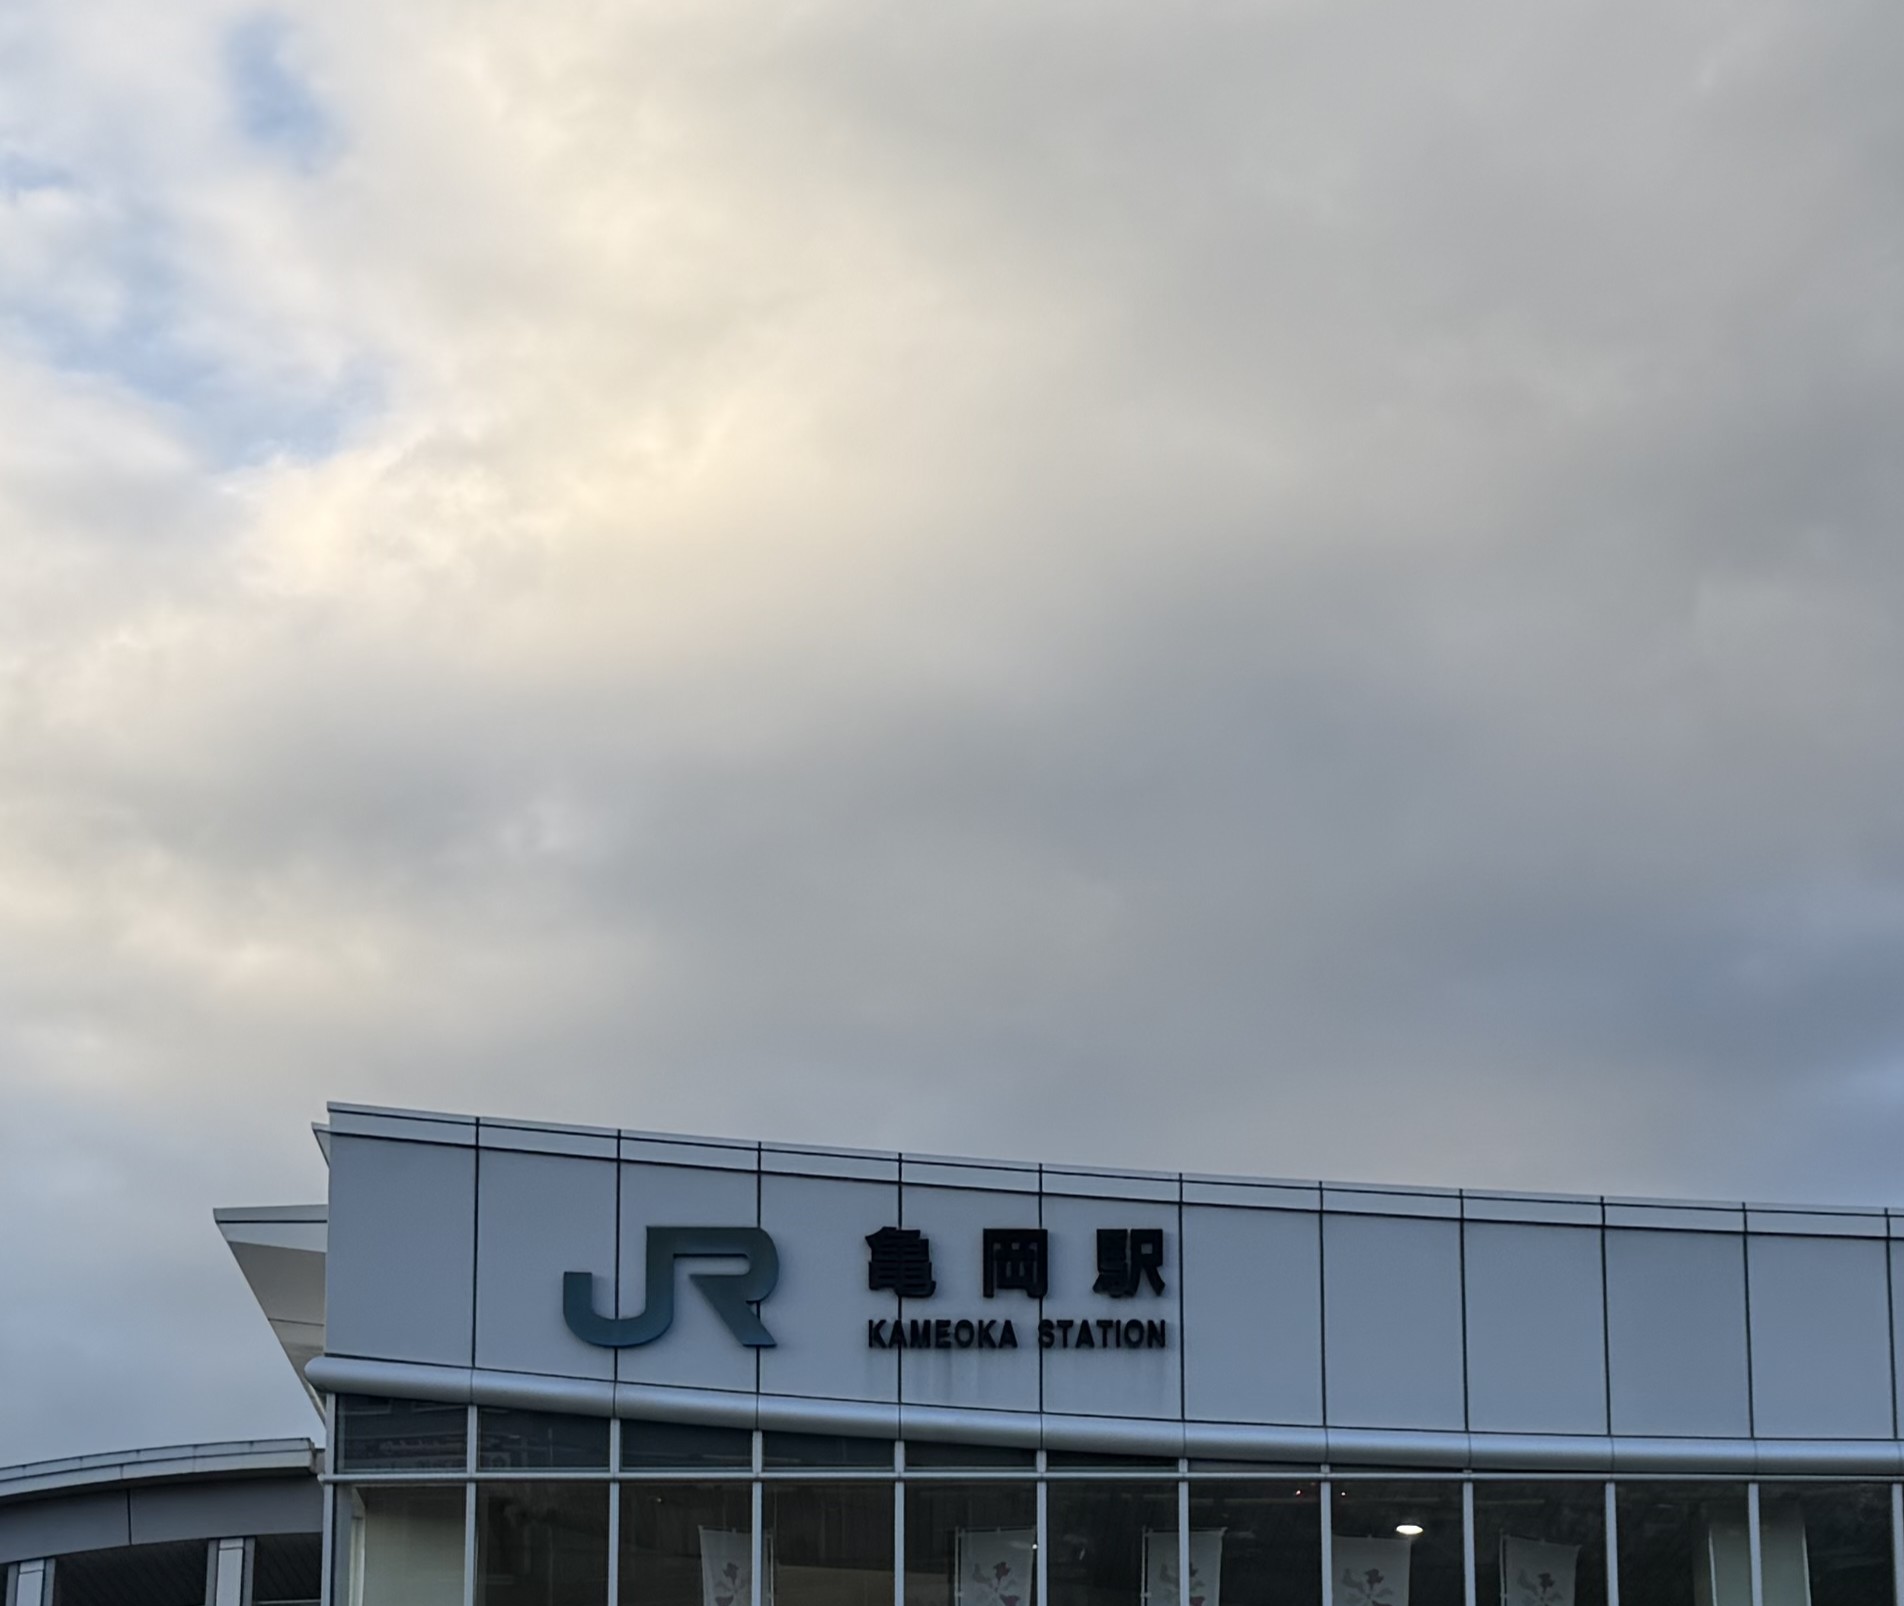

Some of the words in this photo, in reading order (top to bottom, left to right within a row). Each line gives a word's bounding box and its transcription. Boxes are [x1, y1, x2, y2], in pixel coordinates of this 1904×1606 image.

[562, 1226, 779, 1347] JR
[864, 1227, 1166, 1298] 亀岡駅
[868, 1318, 1017, 1350] KAMEOKA
[1037, 1318, 1167, 1350] STATION
